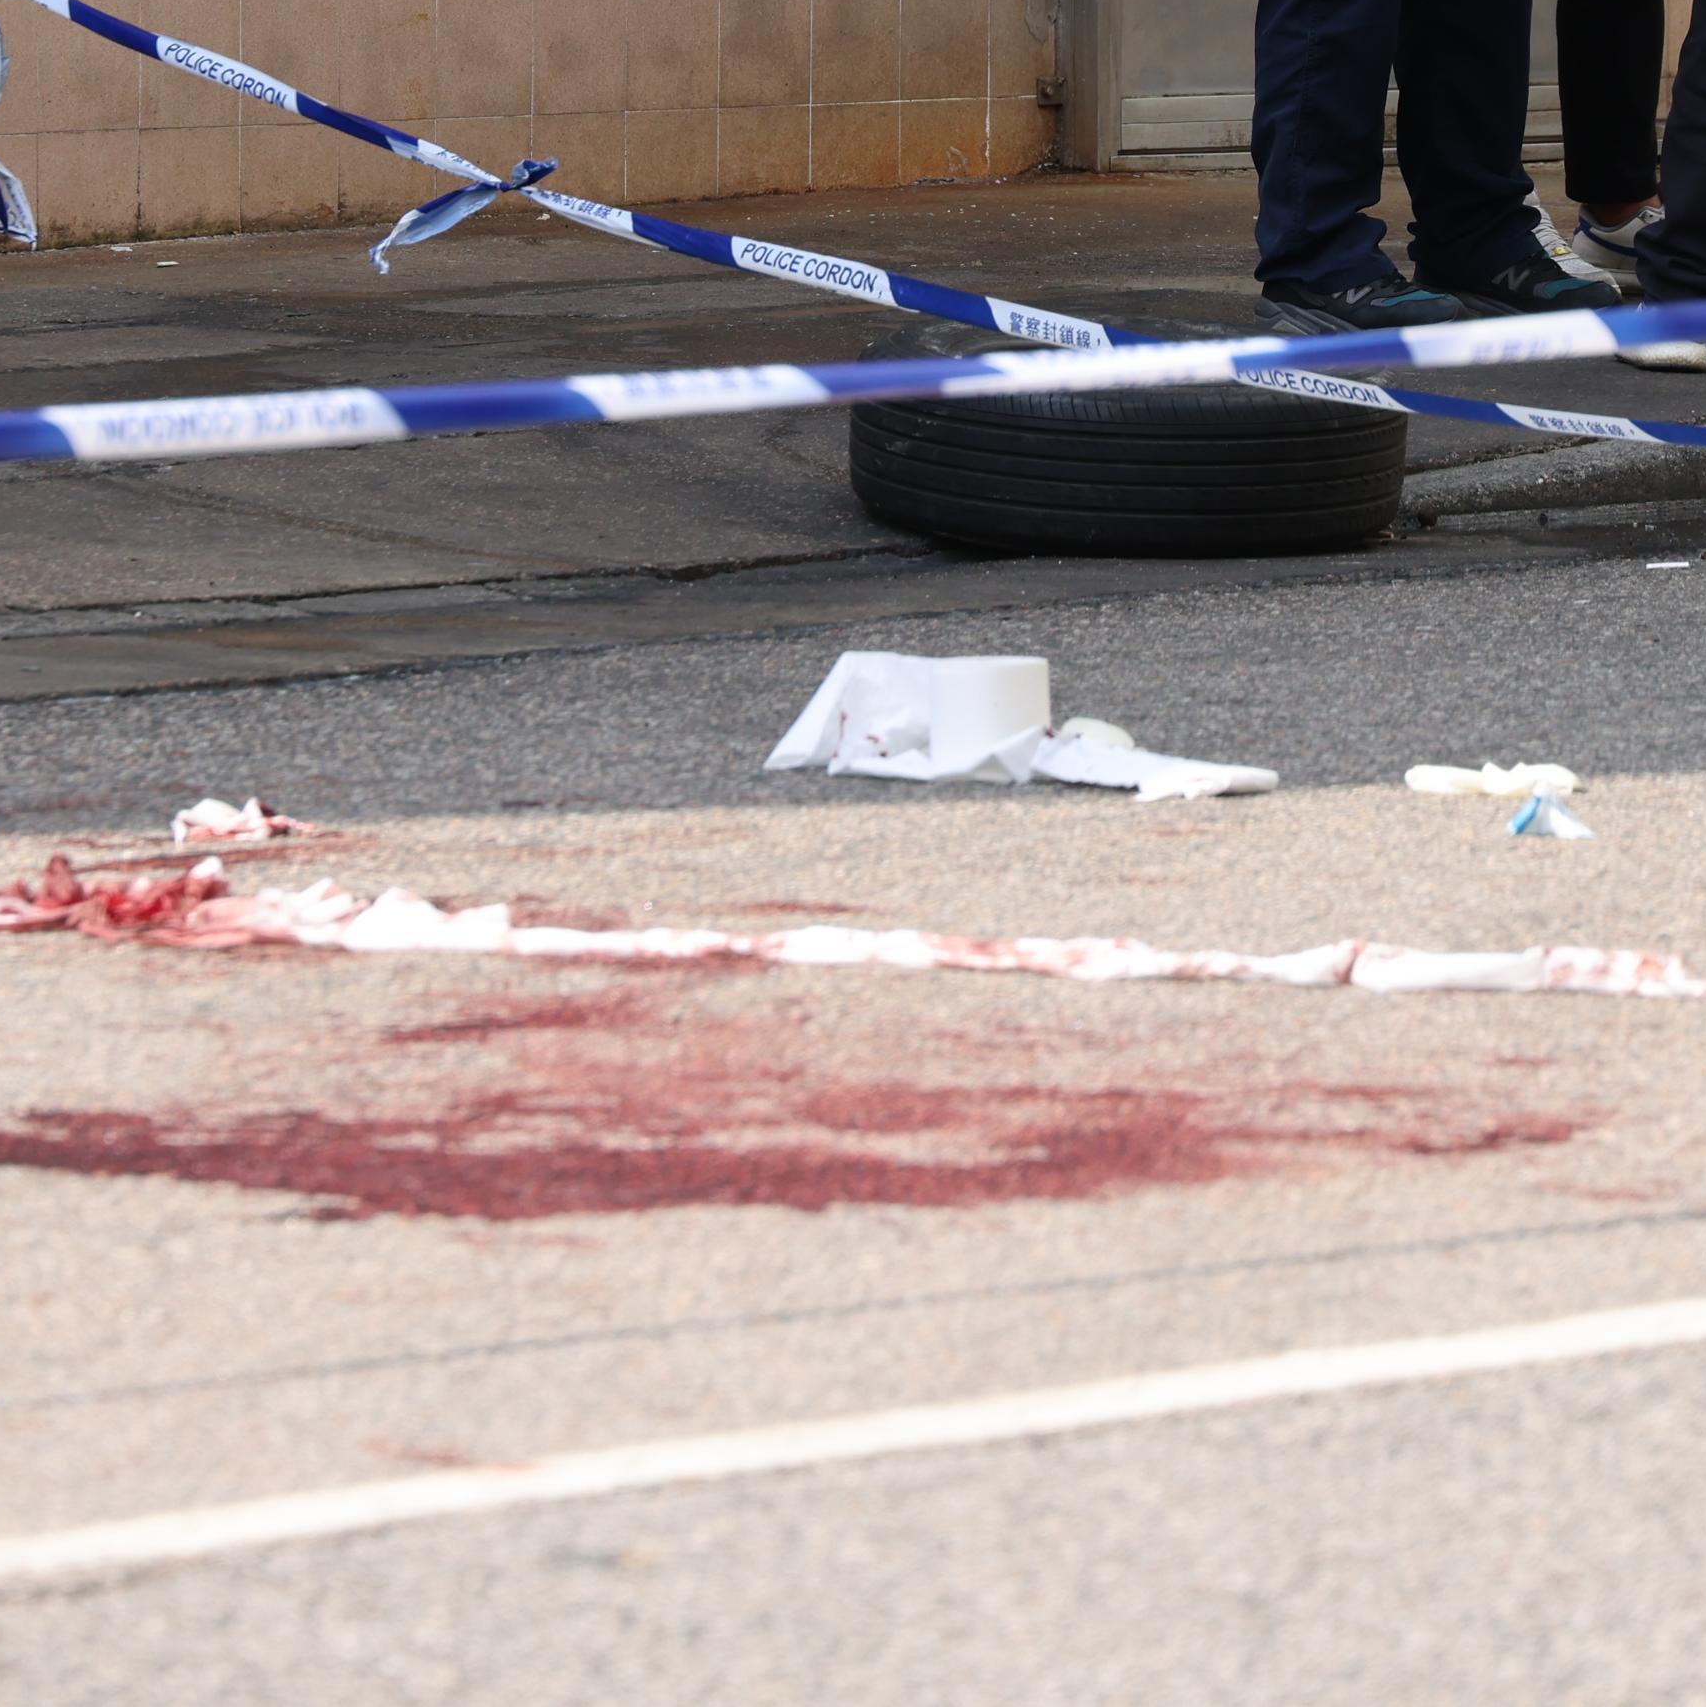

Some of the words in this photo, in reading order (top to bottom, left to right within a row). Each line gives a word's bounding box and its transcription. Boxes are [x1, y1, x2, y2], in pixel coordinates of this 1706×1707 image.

[164, 43, 223, 80] POLICE
[220, 68, 287, 109] CORDON
[741, 243, 804, 273] POLICE
